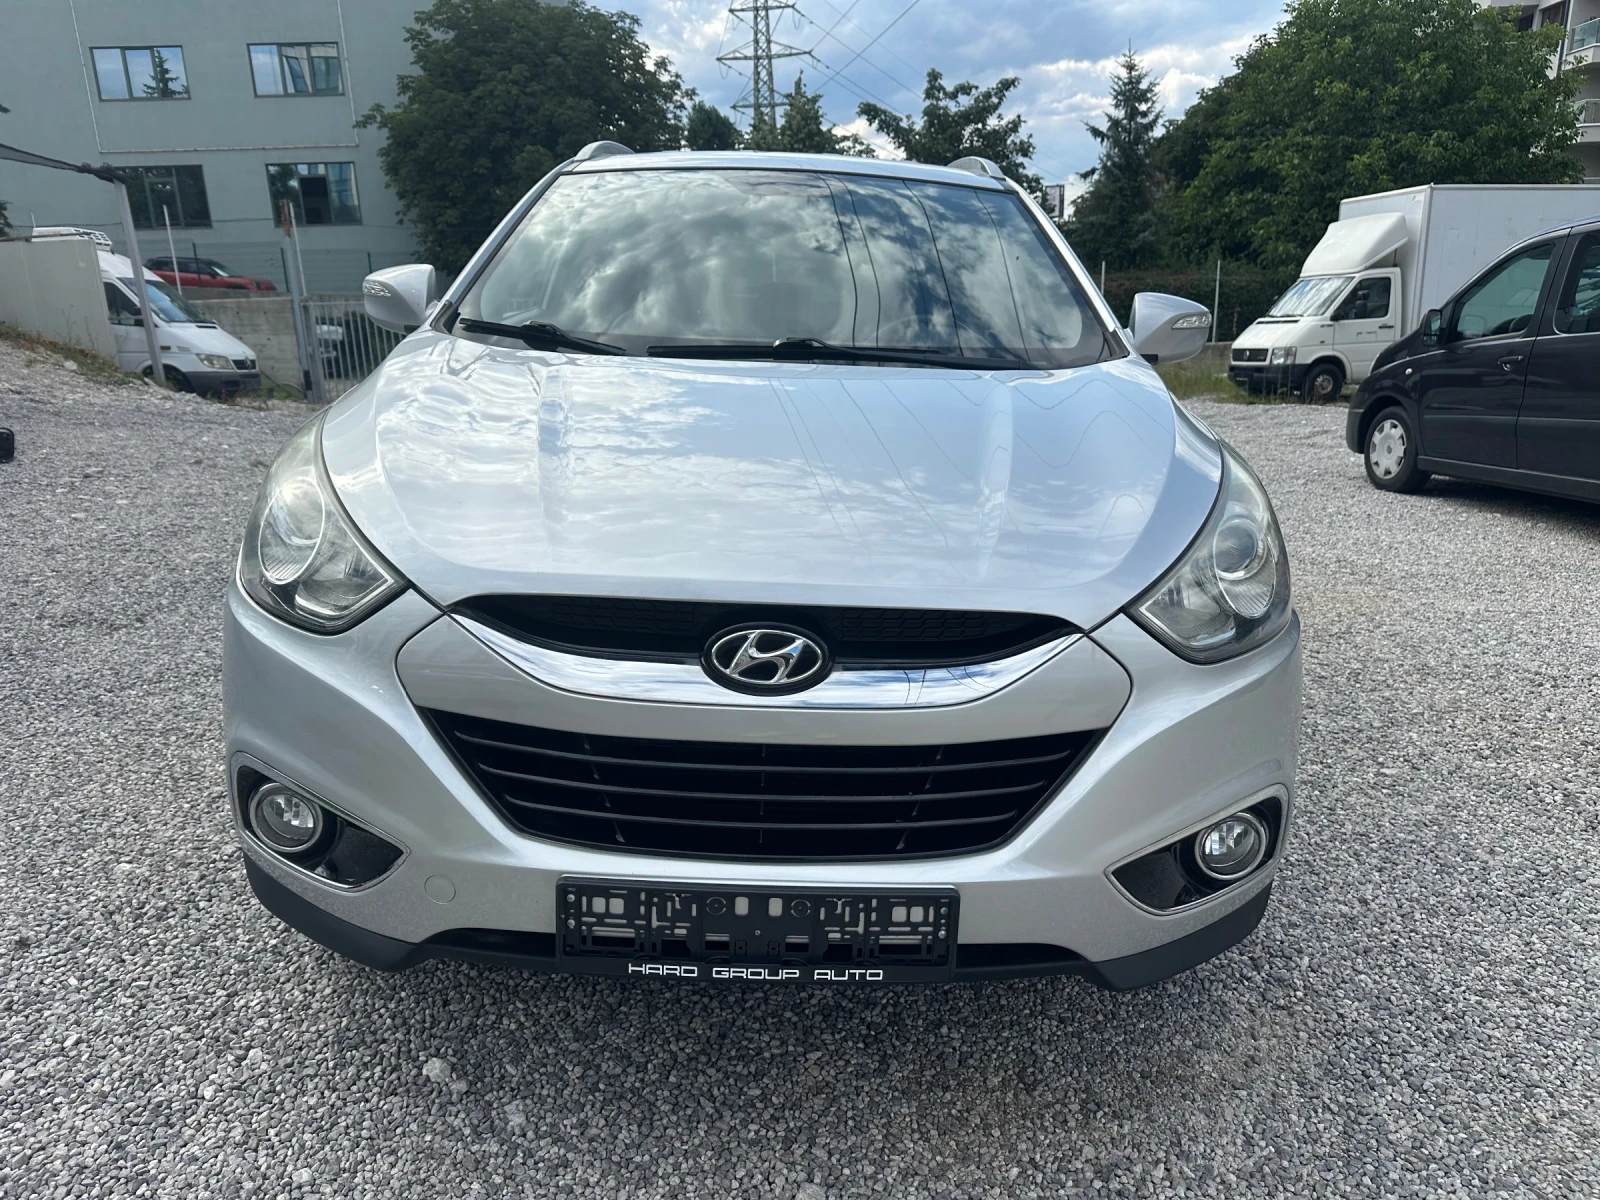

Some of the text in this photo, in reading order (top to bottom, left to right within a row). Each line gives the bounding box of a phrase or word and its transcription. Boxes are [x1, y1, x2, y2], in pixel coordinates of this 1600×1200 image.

[627, 963, 884, 981] HARD GROUP AUTO
